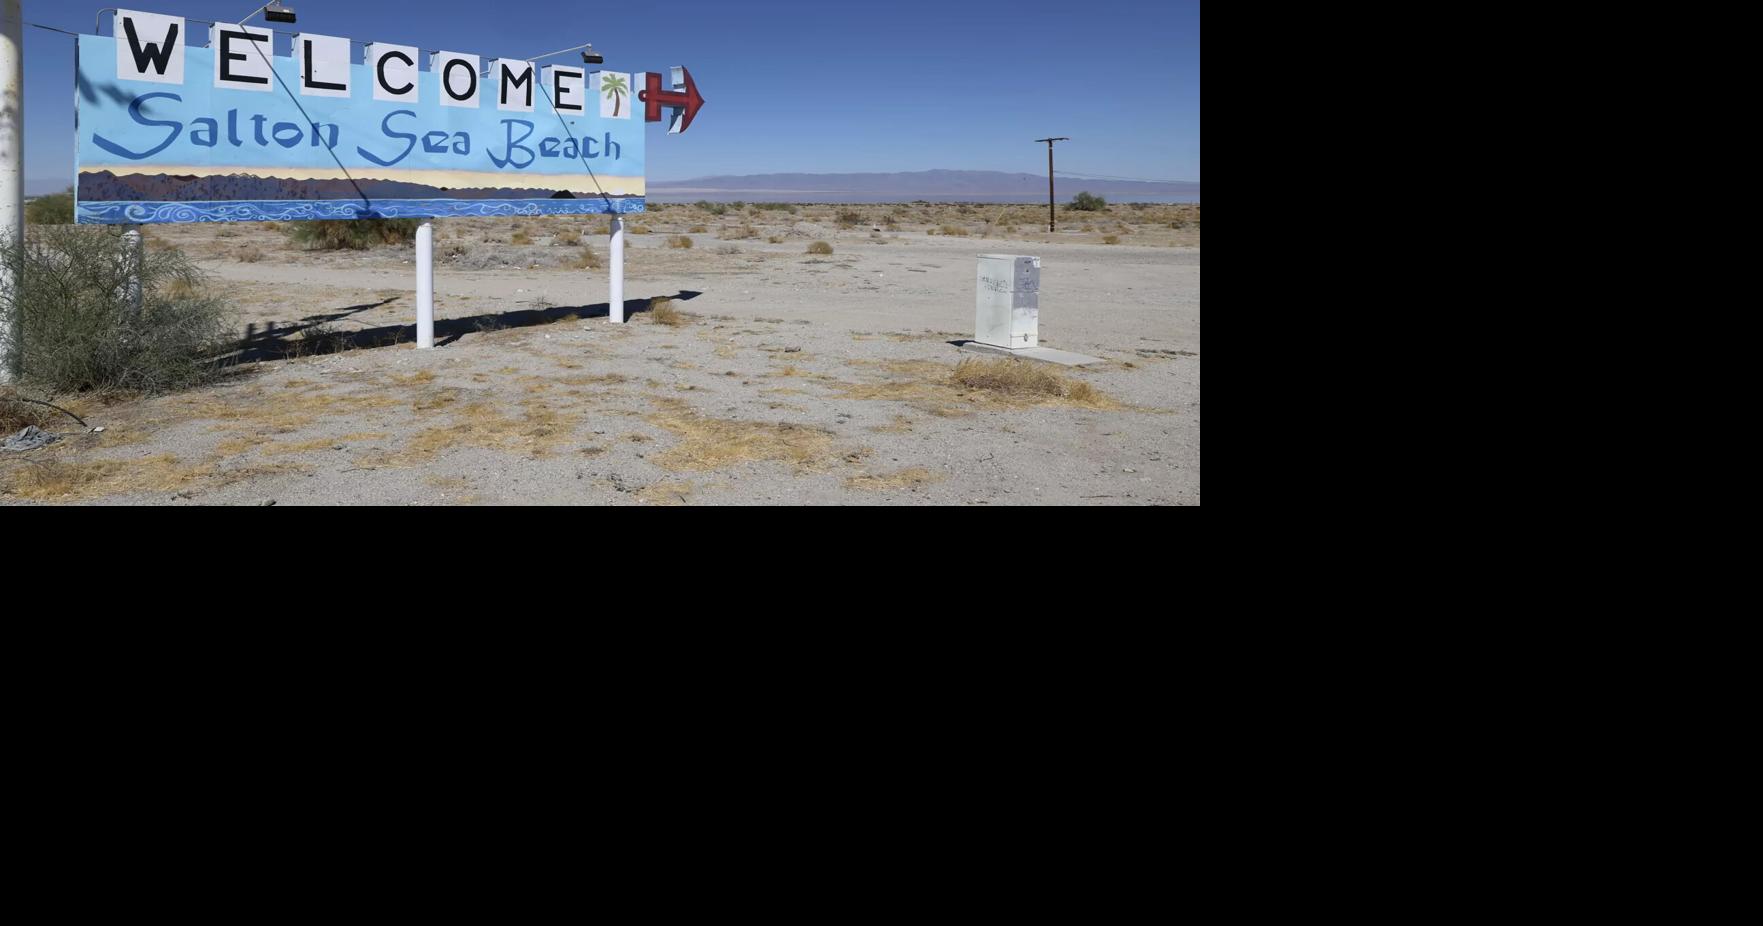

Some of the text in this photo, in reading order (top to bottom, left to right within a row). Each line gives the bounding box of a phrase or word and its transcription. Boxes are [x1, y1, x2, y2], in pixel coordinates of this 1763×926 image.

[123, 17, 583, 110] WELCOME
[92, 92, 621, 169] Salton Sea Beach
